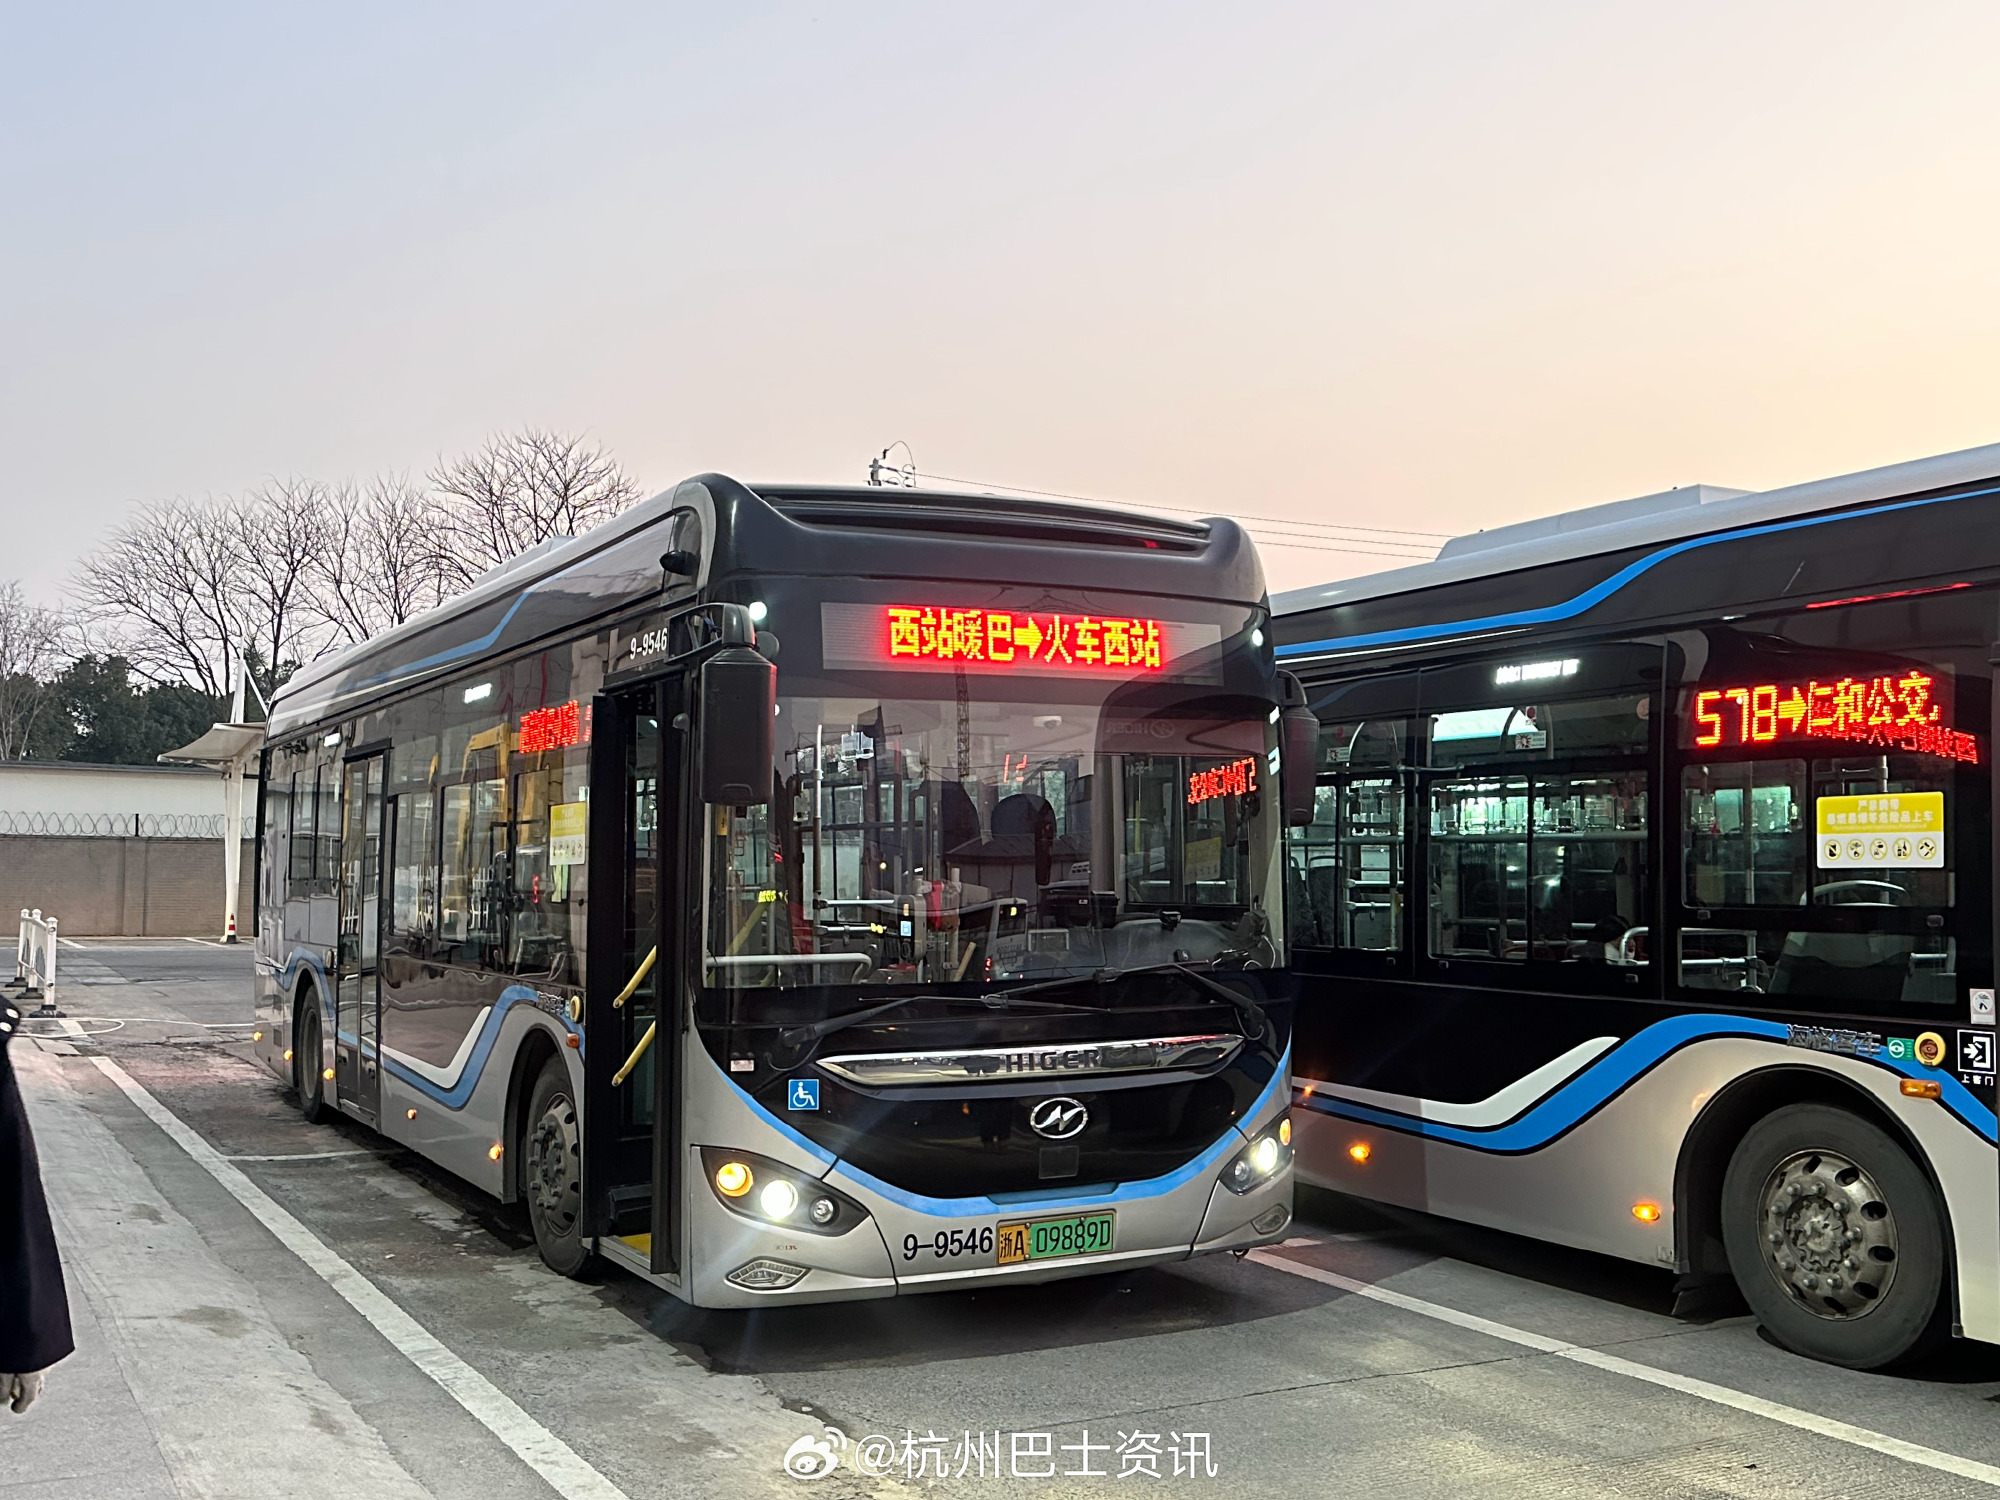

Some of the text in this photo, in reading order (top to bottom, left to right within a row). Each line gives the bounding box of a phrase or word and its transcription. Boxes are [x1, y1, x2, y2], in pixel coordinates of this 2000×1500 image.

[630, 628, 667, 660] 9-9546
[888, 607, 1160, 668] 西站暖巴 火车西站
[1696, 684, 1778, 746] 578
[1807, 671, 1939, 734] 仁和公交
[1006, 1049, 1101, 1072] HIGER
[903, 1227, 993, 1260] 9-9546
